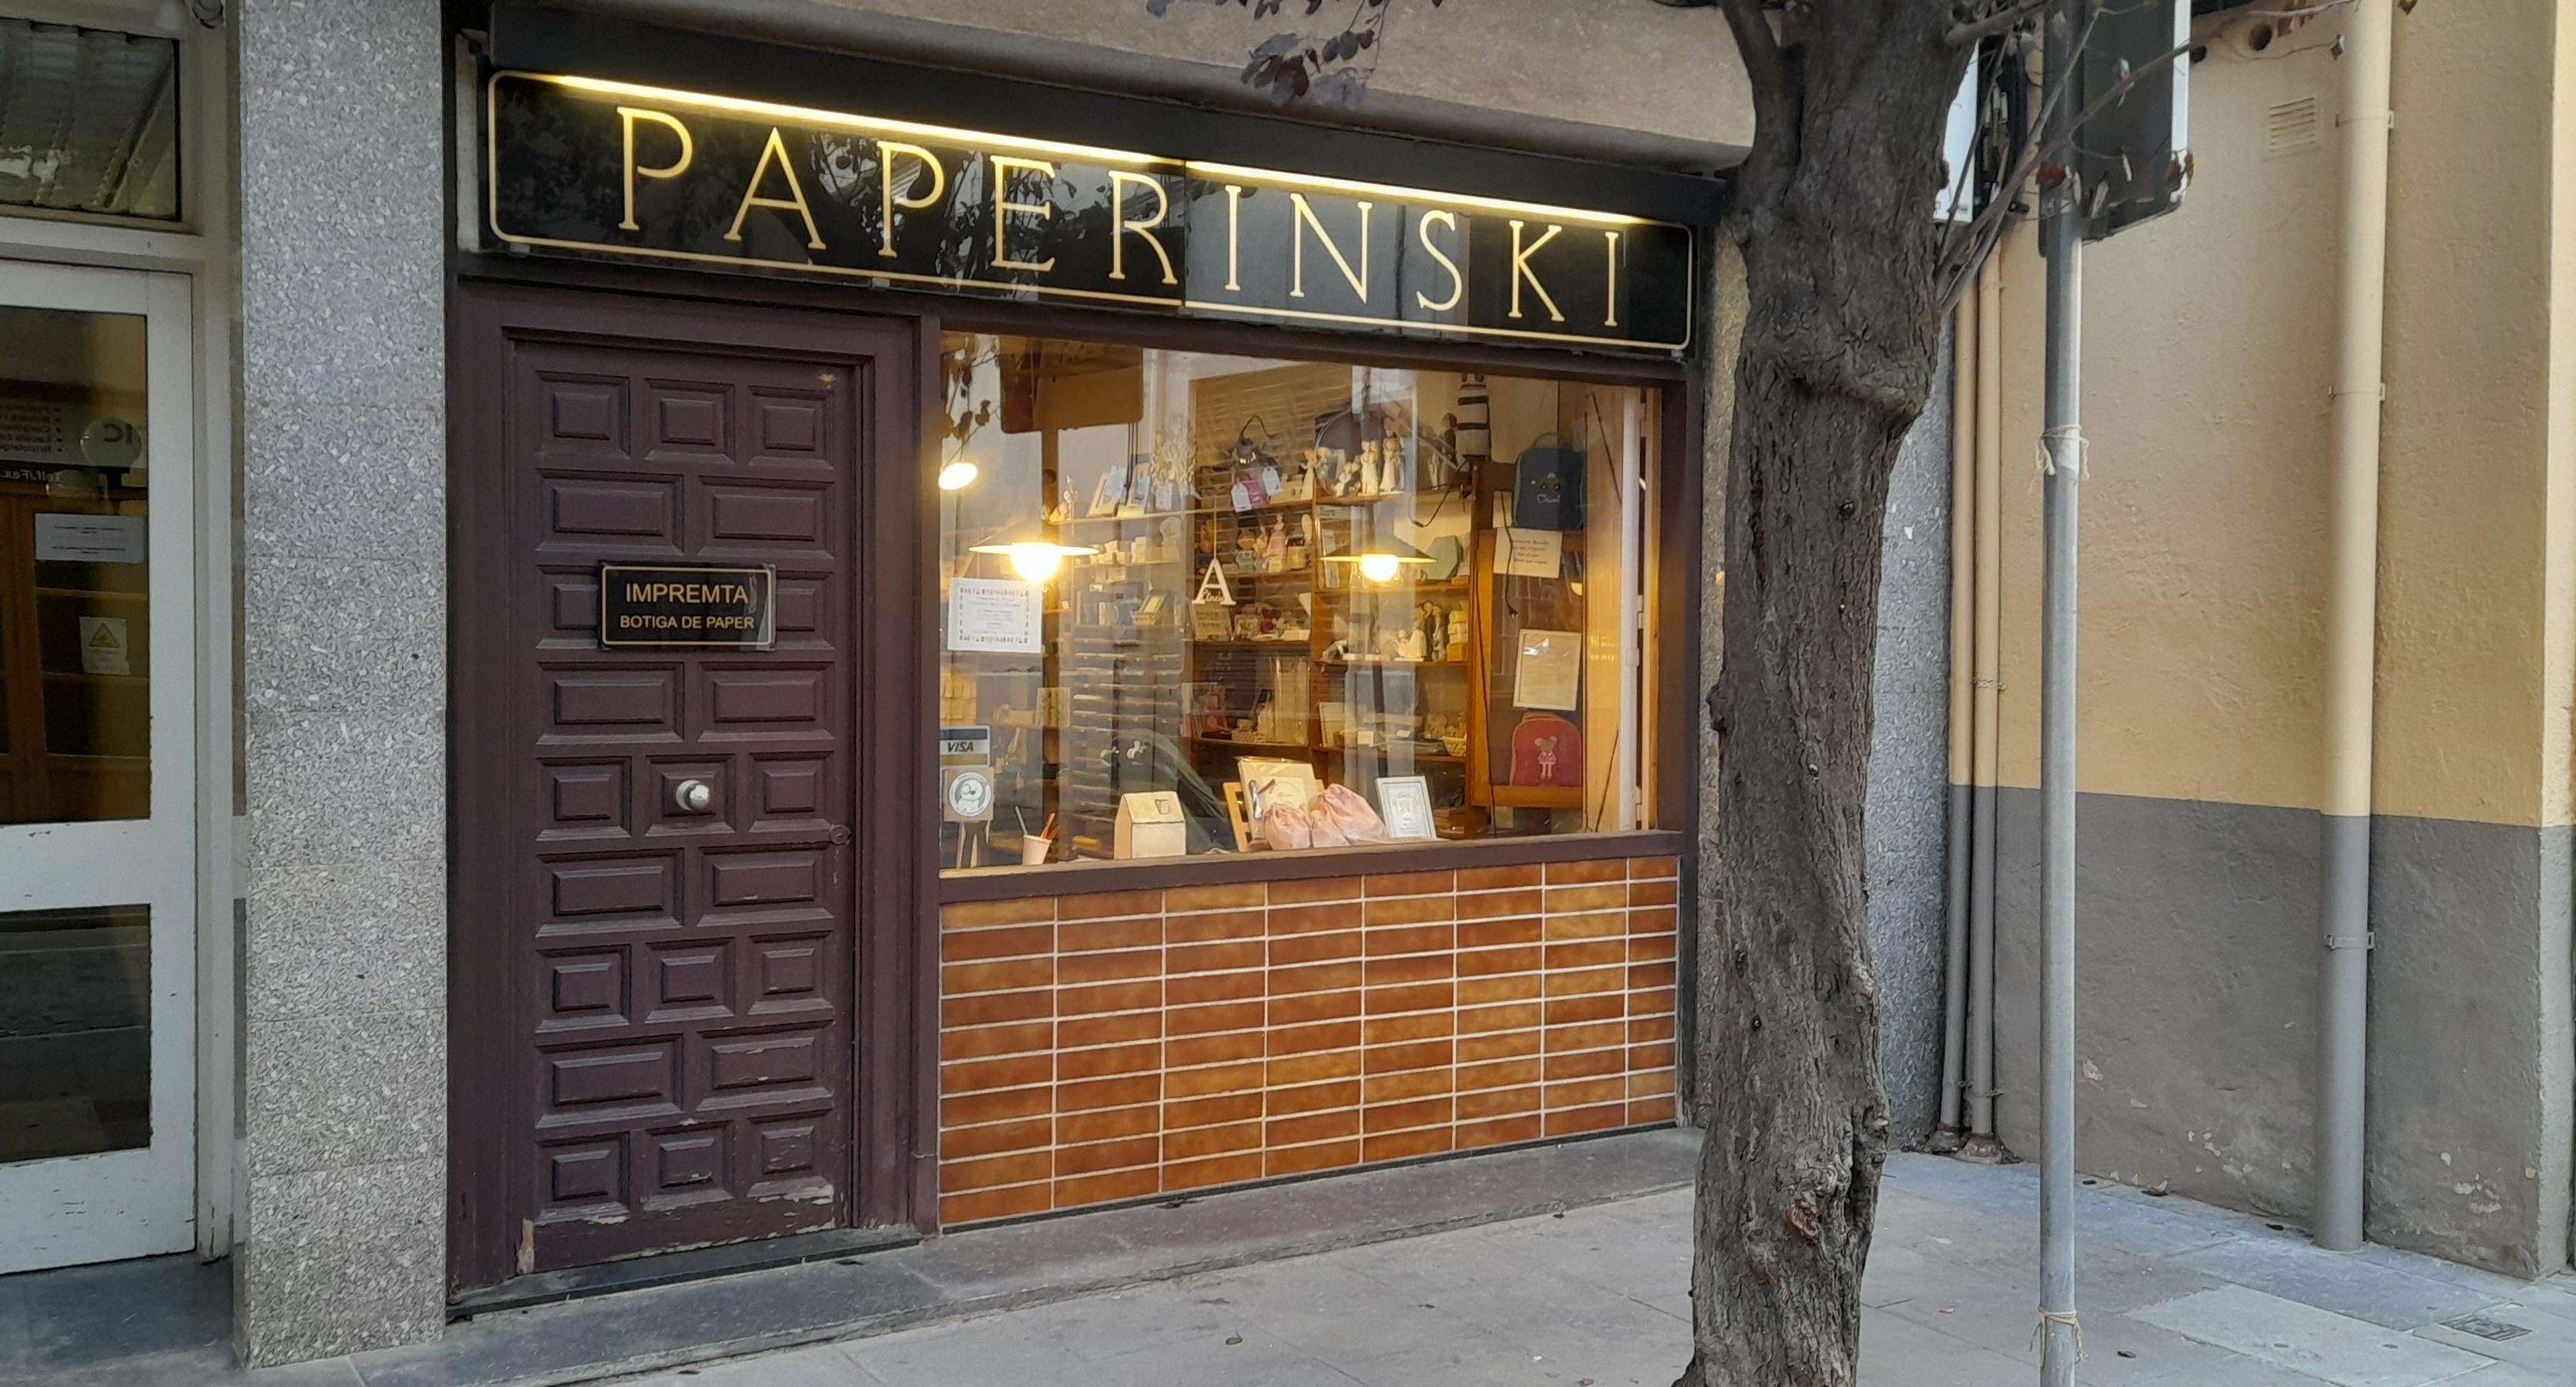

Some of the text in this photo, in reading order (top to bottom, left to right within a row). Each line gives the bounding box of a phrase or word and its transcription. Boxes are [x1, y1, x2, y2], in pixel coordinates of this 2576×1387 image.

[617, 106, 1618, 327] PAPERINSKI
[626, 583, 749, 604] IMPREMTA
[619, 615, 755, 630] BOTIGA DE PAPER
[948, 741, 974, 753] VISA
